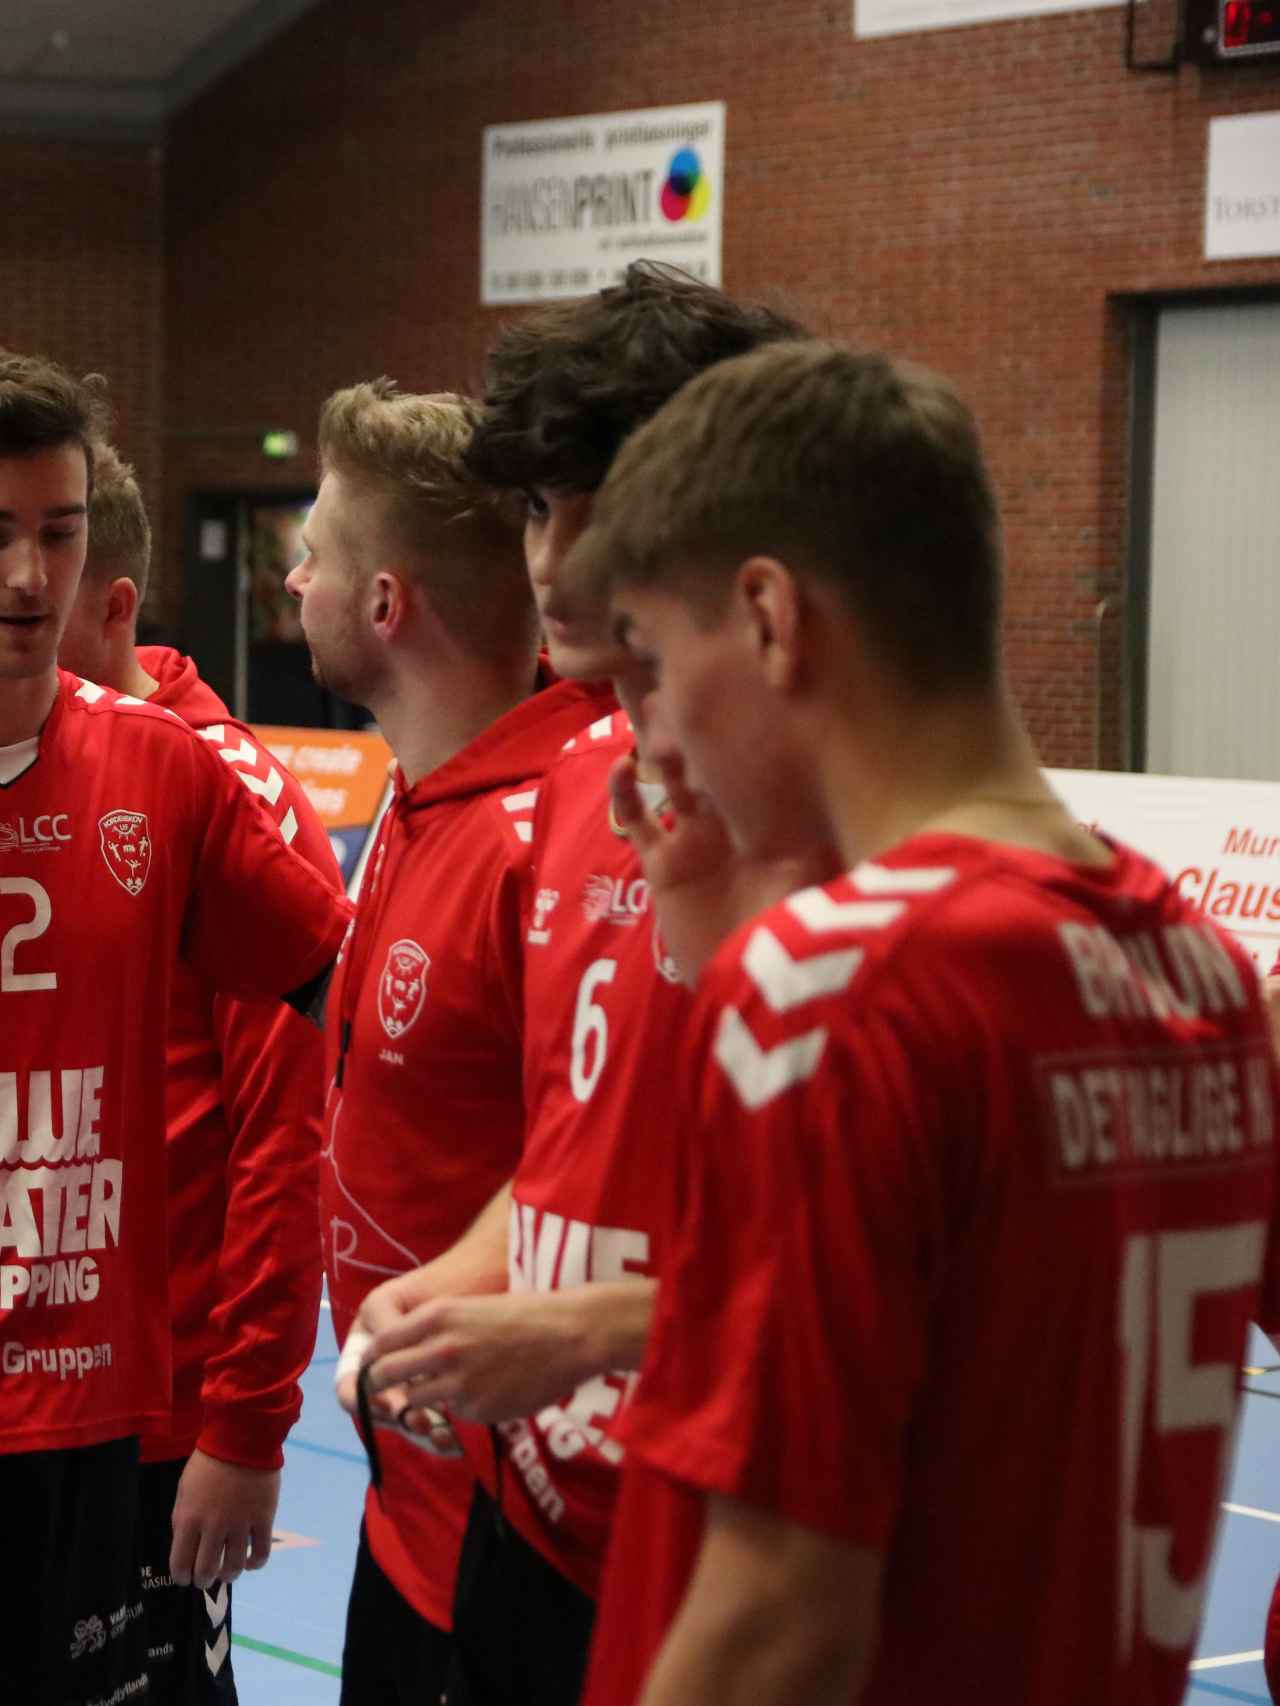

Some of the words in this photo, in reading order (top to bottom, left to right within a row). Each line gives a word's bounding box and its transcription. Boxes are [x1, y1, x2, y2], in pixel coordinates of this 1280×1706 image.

[19, 813, 72, 843] LCC
[0, 876, 58, 993] 2
[570, 958, 618, 1104] 6
[2, 1341, 113, 1382] Gruppen
